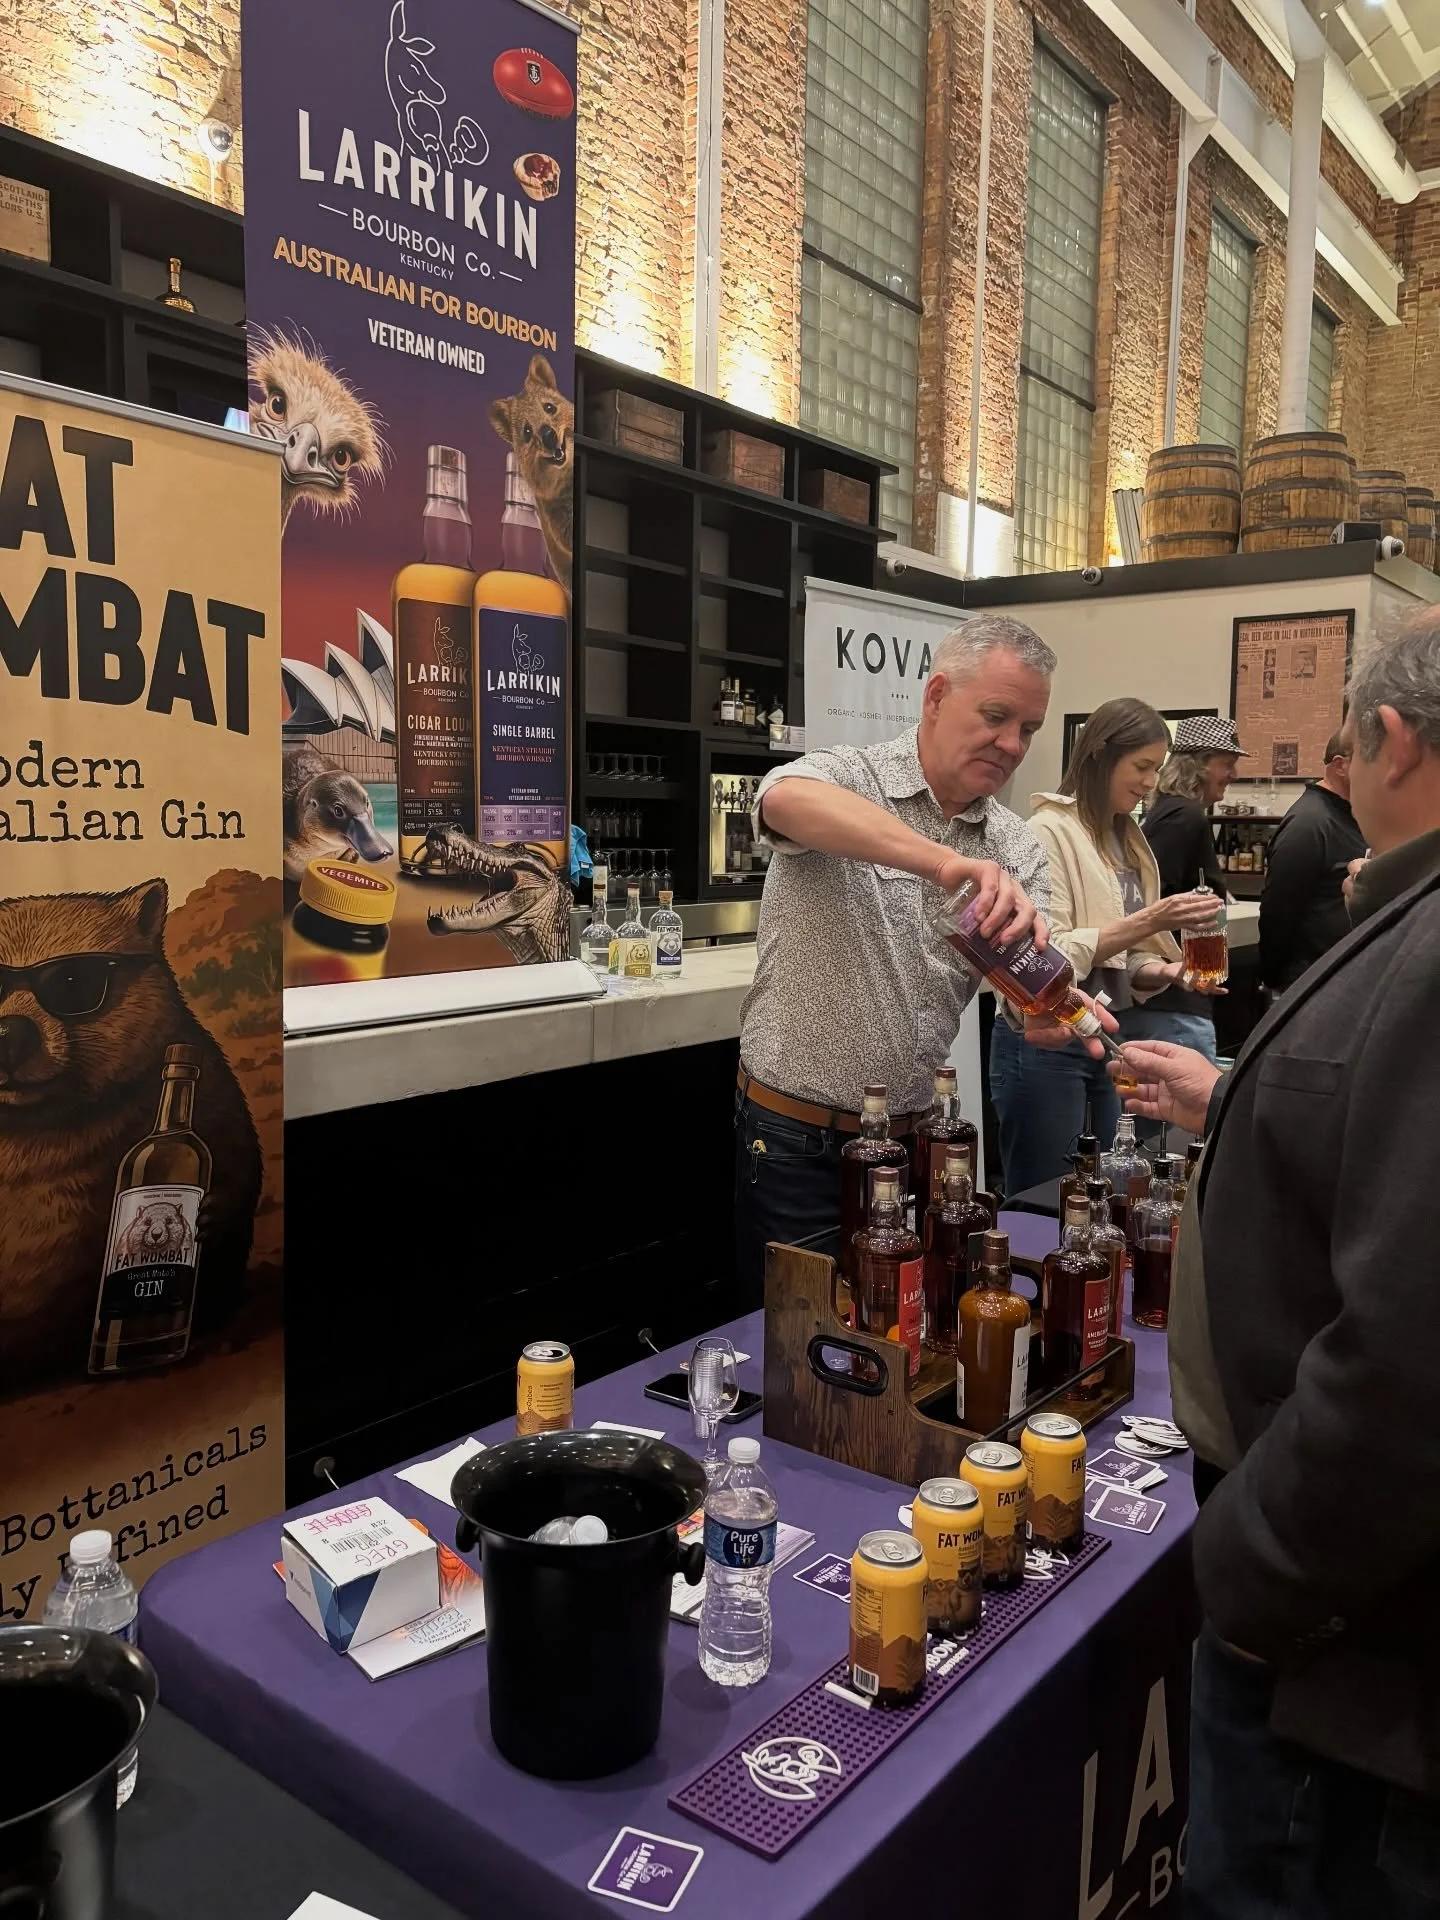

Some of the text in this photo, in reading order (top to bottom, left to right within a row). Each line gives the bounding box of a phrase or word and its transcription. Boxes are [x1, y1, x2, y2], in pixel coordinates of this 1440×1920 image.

[299, 109, 537, 270] LARRIKIN
[353, 208, 496, 280] BOURBON Co.
[400, 252, 454, 281] KENTUCKY
[273, 236, 557, 352] AUSTRALIAN FOR BOURBON
[368, 318, 485, 375] VETERAN OWNED
[0, 415, 133, 565] AT
[0, 566, 265, 735] MBAT
[423, 688, 457, 698] BOURBON
[487, 669, 561, 699] LARRIKIN
[502, 694, 534, 705] BOURBON
[407, 714, 441, 731] CIGAR
[492, 723, 556, 740] SINGLE BARREL
[417, 758, 448, 767] BOURBON
[161, 800, 245, 842] Gin
[321, 867, 384, 890] VEGEMITE
[114, 1247, 190, 1271] FAT WOMBAT
[134, 1280, 164, 1298] GIN
[0, 1424, 267, 1556] Bottanicals
[997, 1490, 1017, 1508] FAT
[730, 1530, 759, 1544] Pure
[938, 1533, 960, 1549] FAT
[355, 1539, 408, 1567] GREG
[733, 1543, 756, 1558] Life
[616, 1842, 655, 1892] LARRIKIN
